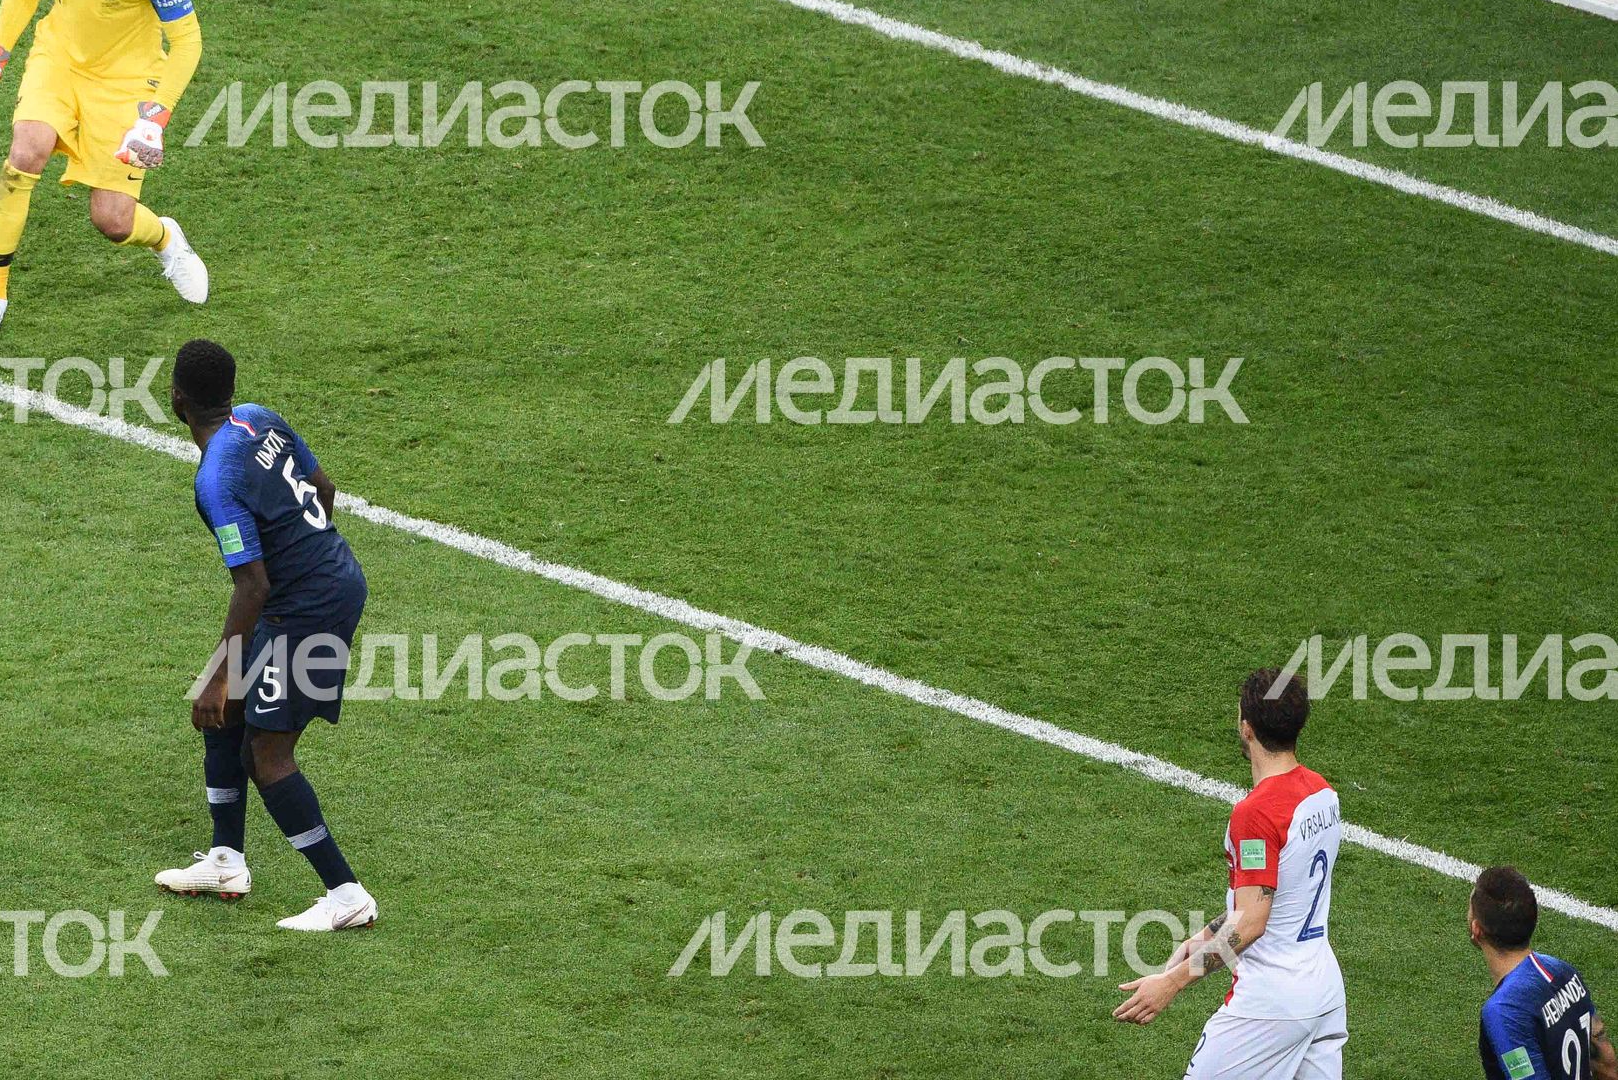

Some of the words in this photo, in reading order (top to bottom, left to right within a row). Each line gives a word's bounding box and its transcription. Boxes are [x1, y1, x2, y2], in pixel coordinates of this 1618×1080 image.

[282, 455, 327, 529] 5
[258, 666, 281, 702] 5
[1300, 804, 1339, 841] VRSALJK
[1297, 849, 1328, 942] 2
